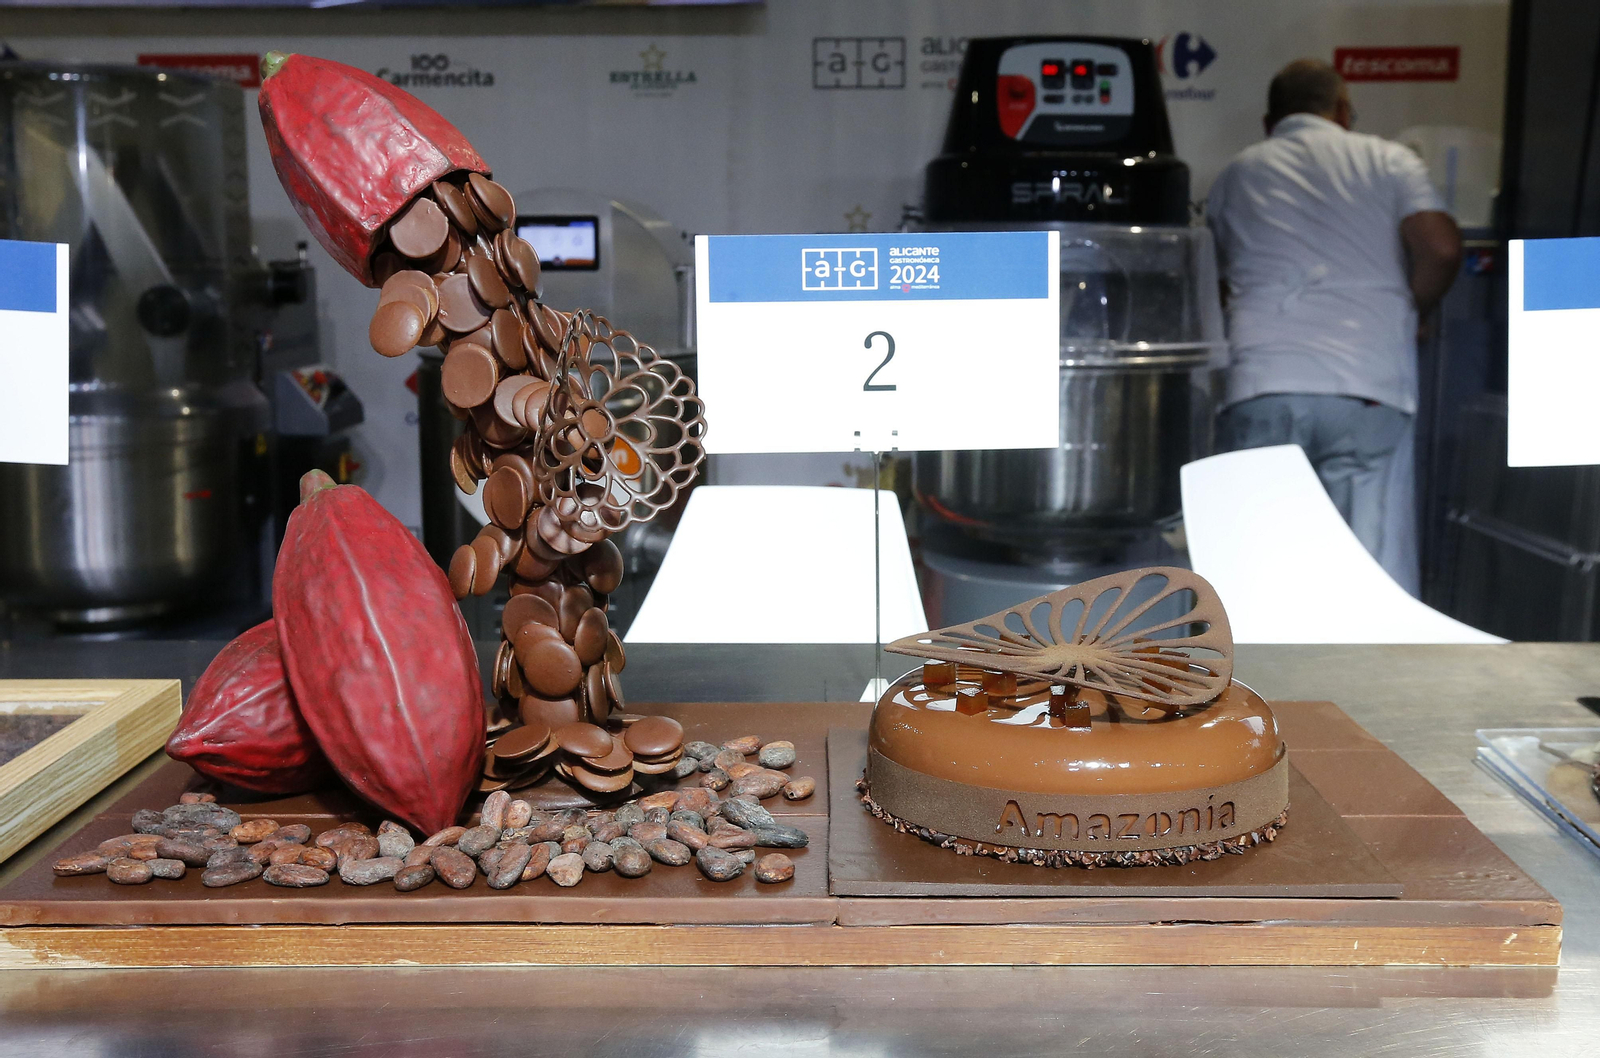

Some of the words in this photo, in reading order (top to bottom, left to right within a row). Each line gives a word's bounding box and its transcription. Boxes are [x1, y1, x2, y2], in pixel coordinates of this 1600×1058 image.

[411, 53, 450, 71] 100
[1342, 55, 1450, 74] tescoma
[609, 70, 697, 83] ESTRELLA
[889, 265, 940, 284] 2024
[863, 331, 897, 392] 2
